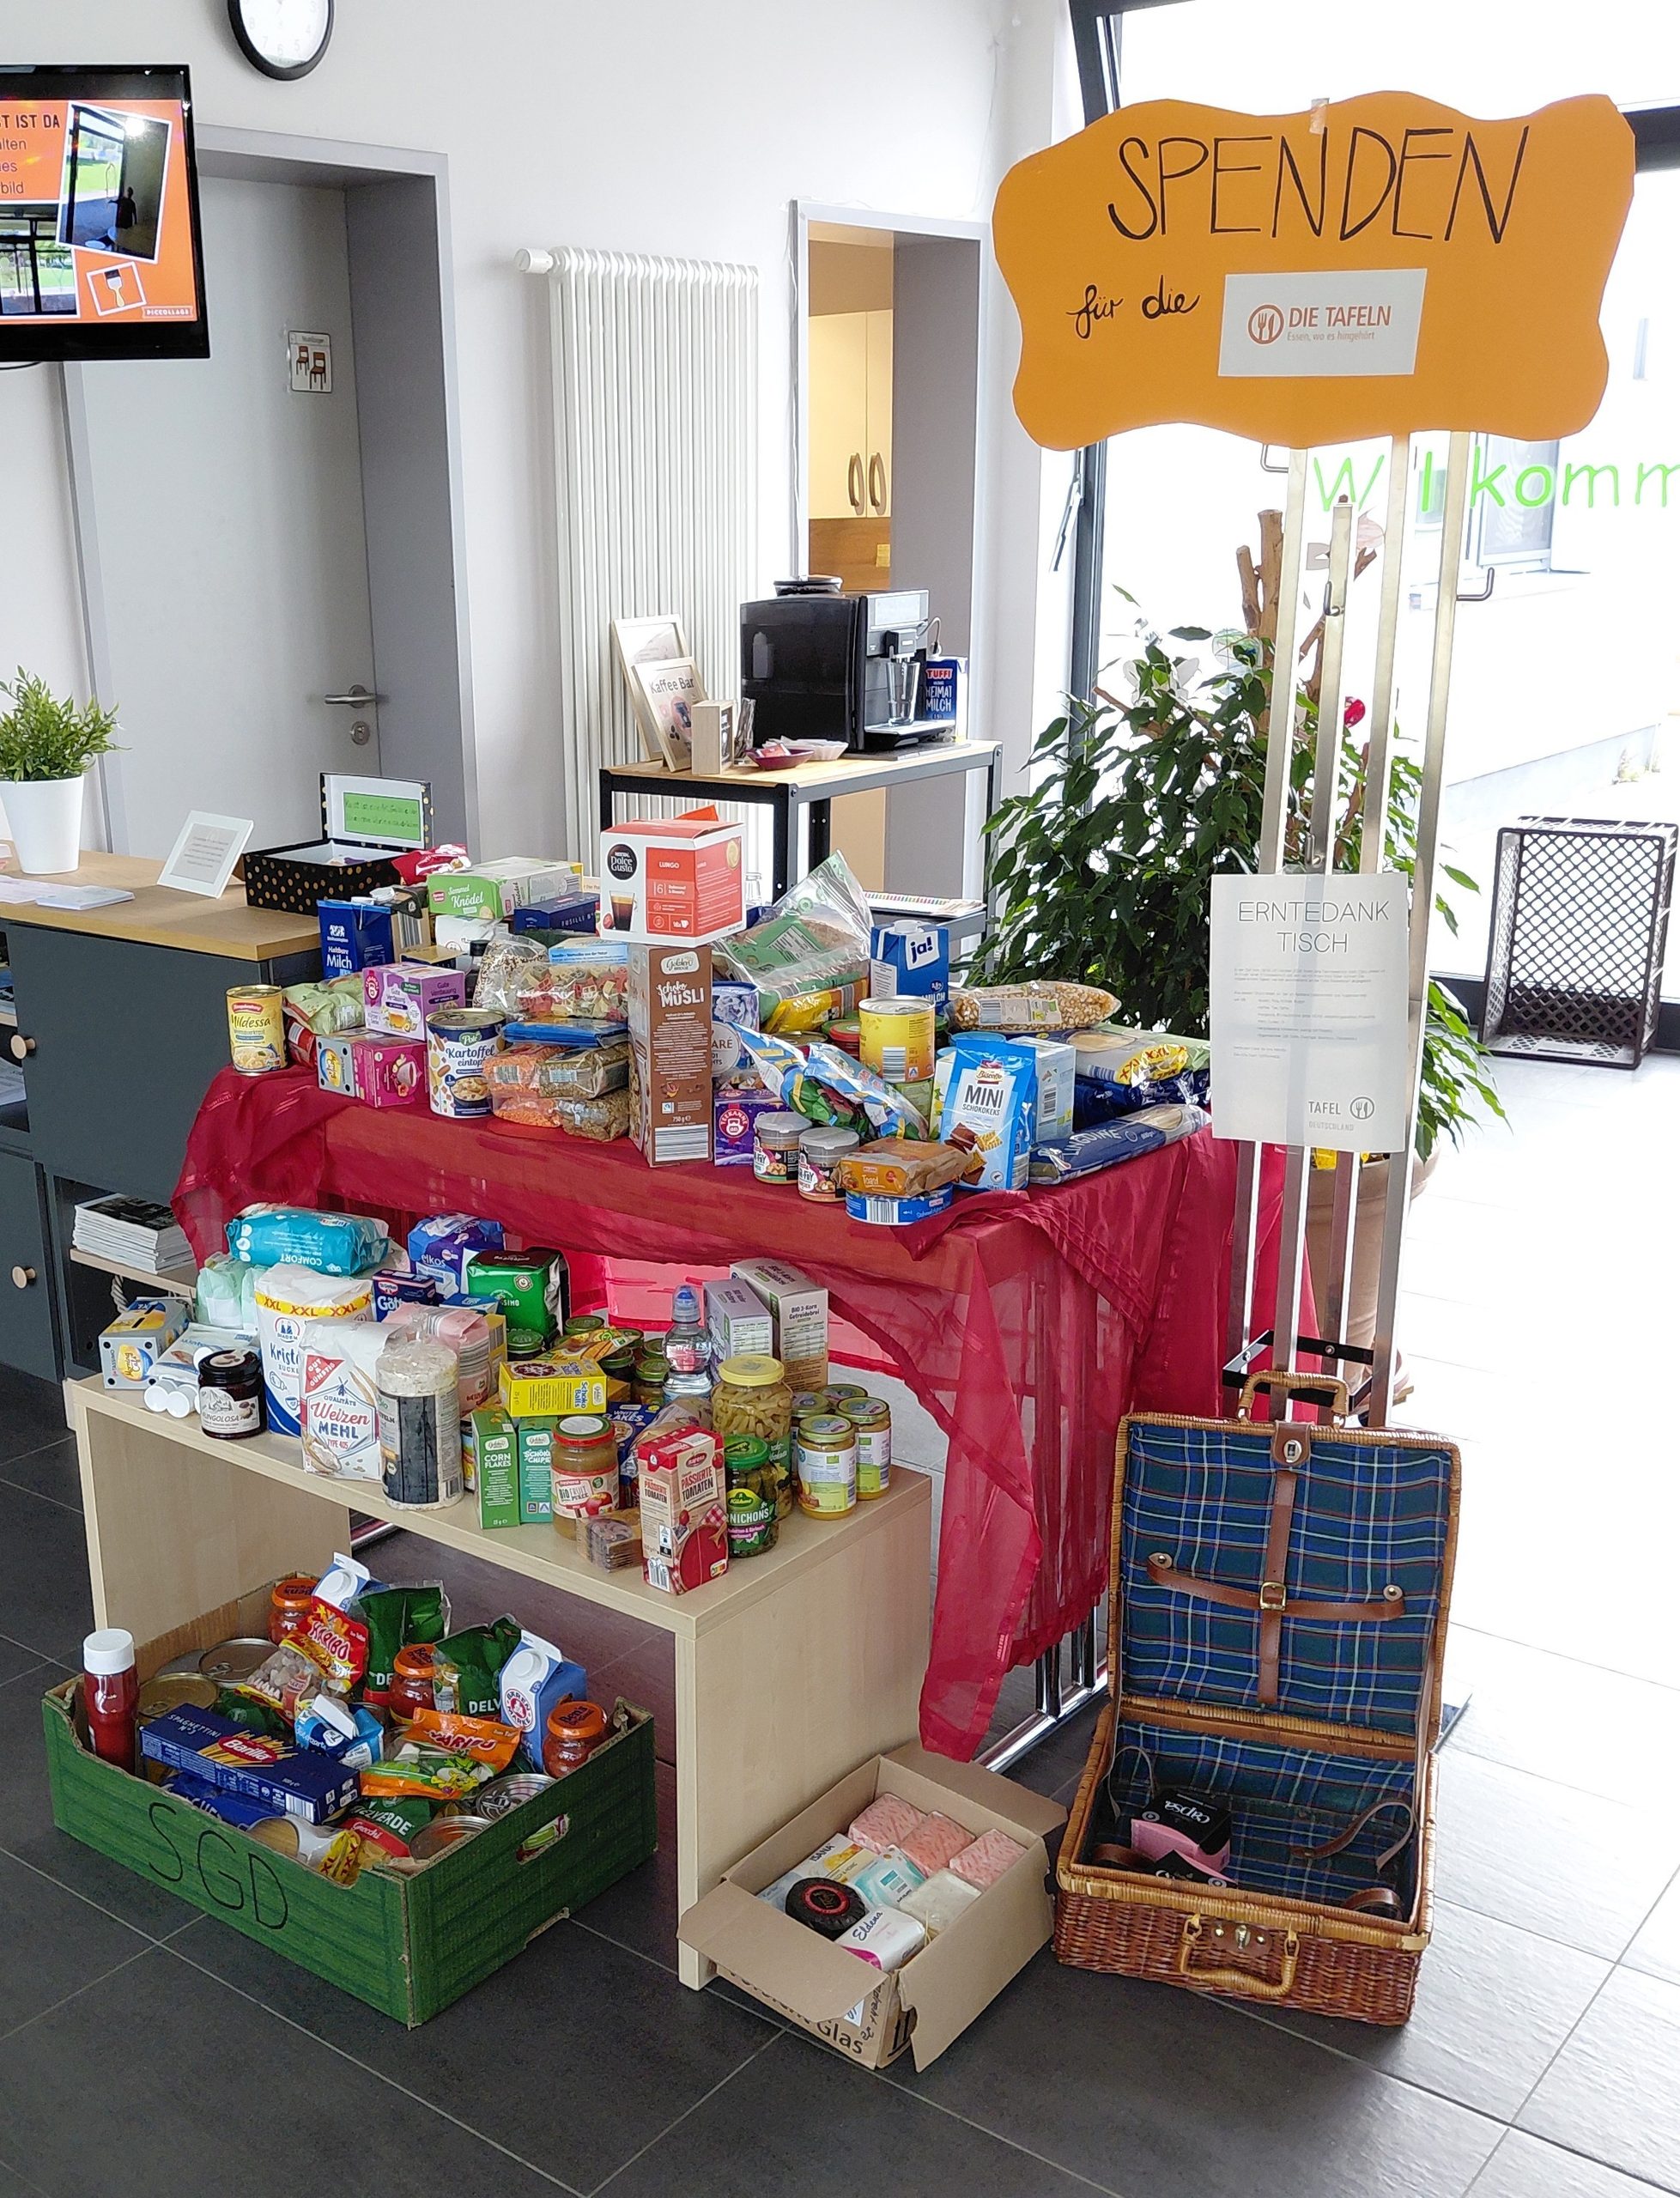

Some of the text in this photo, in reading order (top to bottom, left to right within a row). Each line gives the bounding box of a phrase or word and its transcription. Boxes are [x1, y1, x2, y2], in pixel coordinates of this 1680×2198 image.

[15, 114, 37, 128] IST
[43, 113, 60, 129] DA
[1107, 124, 1529, 244] SPENDEN
[1066, 275, 1200, 339] für die
[1289, 305, 1392, 327] DIE TAFELN
[1288, 331, 1311, 342] Essen,
[1313, 446, 1680, 513] Wlkomm
[927, 670, 952, 679] TUFFI
[649, 677, 694, 694] Kaffee Bar
[926, 686, 952, 698] HEIMAT
[926, 699, 952, 712] MILCH
[610, 856, 633, 866] Dolce
[610, 863, 633, 873] Gusto
[656, 883, 664, 894] 6
[451, 891, 485, 908] Knödel
[1239, 901, 1390, 923] ERNTEDANK
[910, 936, 933, 963] ja!
[1277, 931, 1348, 953] TISCH
[327, 954, 352, 969] Milch
[661, 987, 705, 1008] MÜSLI
[712, 1036, 733, 1048] ARÉ
[446, 1045, 495, 1059] Kartoffel
[964, 1084, 1004, 1108] MINI
[961, 1103, 1001, 1116] SCHOKOKEKS
[1308, 1101, 1341, 1115] TAFEL
[719, 1110, 748, 1126] TEEKANNE
[1308, 1120, 1355, 1132] DEUTSCHLAND
[1064, 1129, 1121, 1156] LINGUINE
[280, 1253, 322, 1266] COMFORT
[264, 1296, 282, 1311] XXL
[290, 1305, 318, 1316] XXL
[330, 1302, 358, 1317] XXL
[124, 1352, 135, 1377] Morning
[307, 1357, 322, 1372] GUT
[324, 1395, 357, 1406] QUALITÄTS
[311, 1401, 370, 1425] Weizen
[318, 1421, 359, 1440] MEHL
[327, 1438, 339, 1448] TYPE
[484, 1453, 511, 1462] CORN
[484, 1459, 512, 1469] FLAKES
[681, 1466, 713, 1490] PASSIERTE
[644, 1488, 668, 1503] TOMATEN
[682, 1477, 713, 1502] TOMATEN
[727, 1509, 769, 1524] NICHONS
[307, 1621, 350, 1661] HARIBO
[506, 1691, 531, 1711] BÄREN
[507, 1705, 531, 1726] MARKE
[167, 1714, 222, 1739] SPAGHETTINI
[223, 1739, 272, 1760] Barilla
[1165, 1800, 1210, 1824] capsa
[149, 1802, 288, 1930] SGD
[852, 1910, 883, 1941] Eldena
[816, 2020, 863, 2055] Glas
